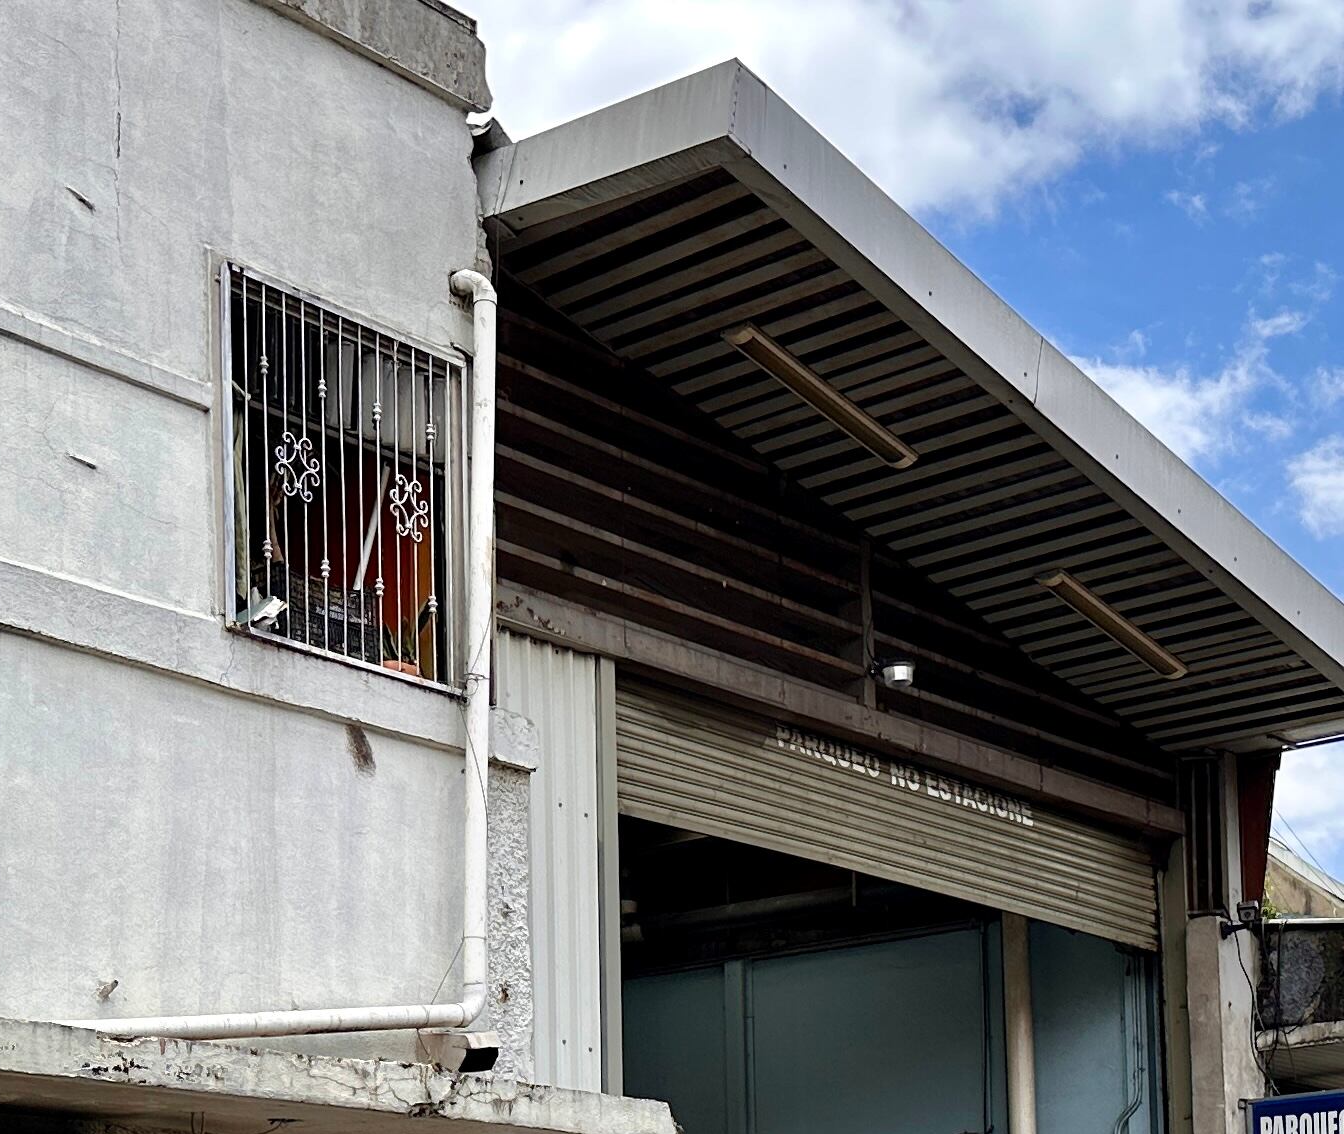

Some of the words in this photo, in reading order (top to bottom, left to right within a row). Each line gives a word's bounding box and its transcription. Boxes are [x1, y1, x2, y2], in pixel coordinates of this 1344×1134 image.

[775, 724, 880, 778] PARQUEO
[889, 761, 920, 791] NO
[925, 774, 1034, 826] ESTACIONE
